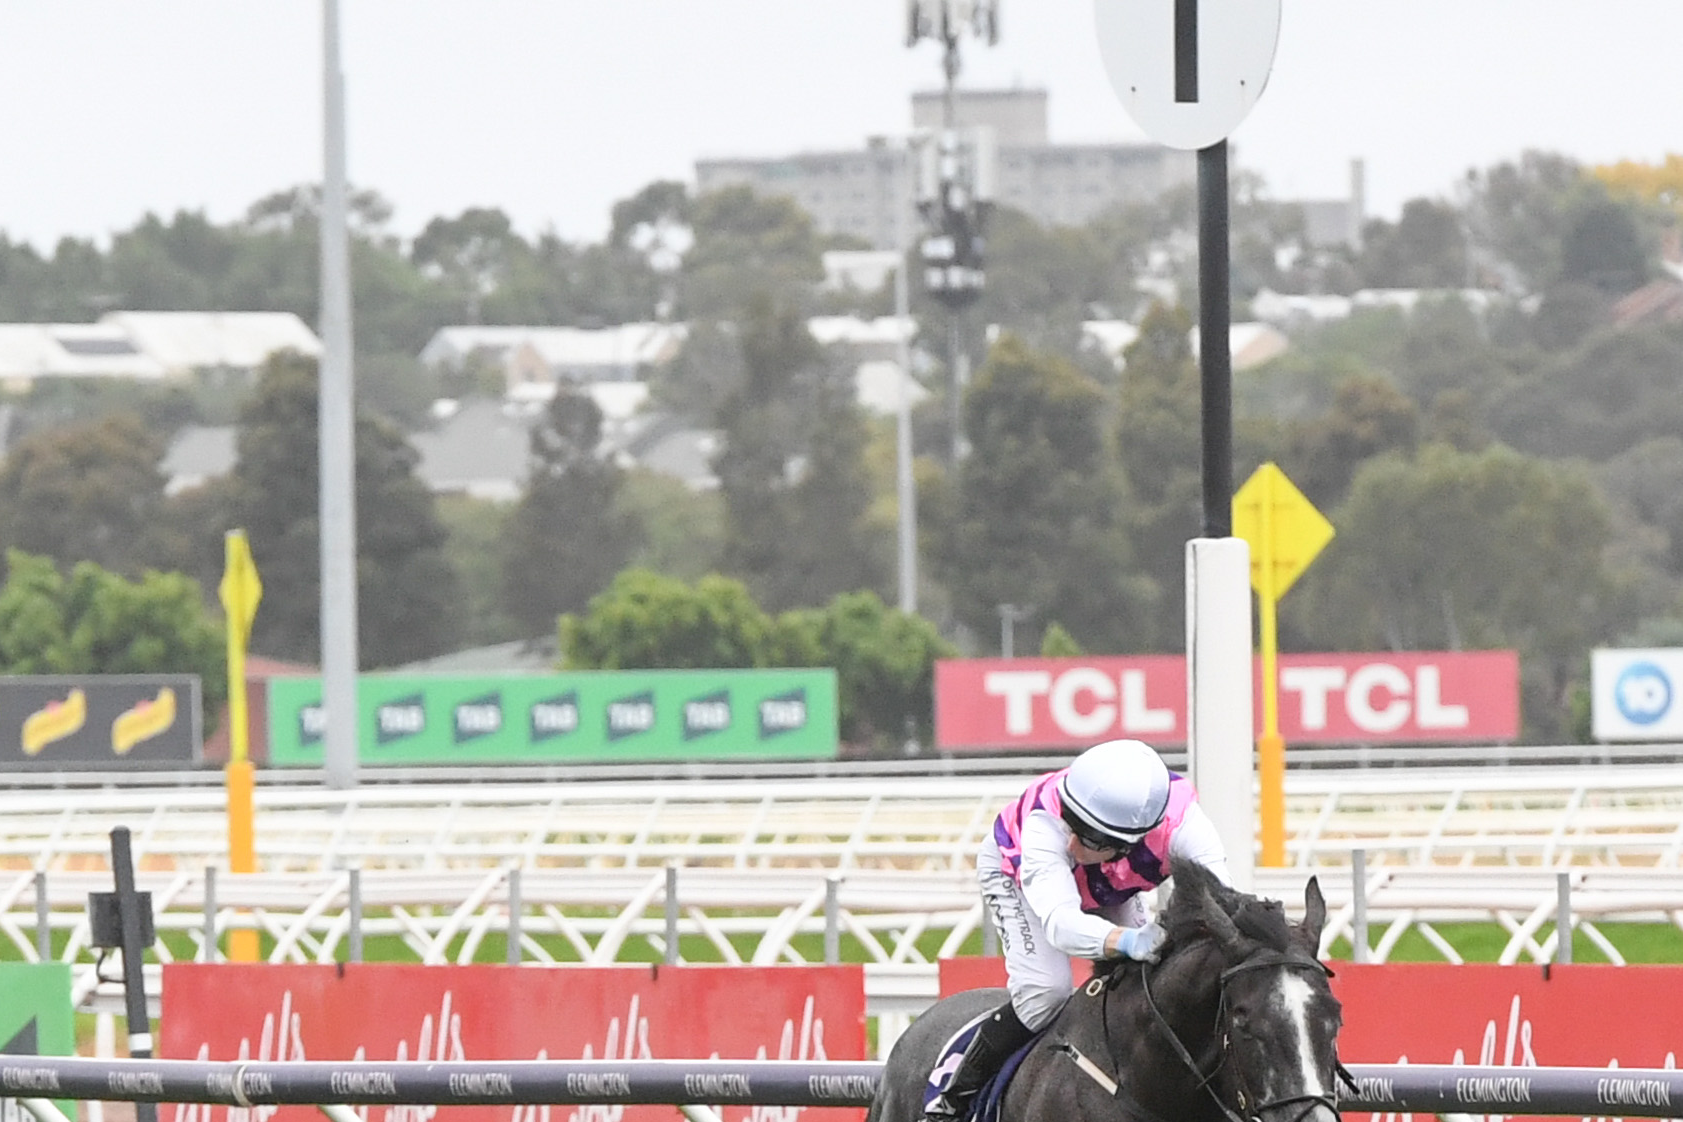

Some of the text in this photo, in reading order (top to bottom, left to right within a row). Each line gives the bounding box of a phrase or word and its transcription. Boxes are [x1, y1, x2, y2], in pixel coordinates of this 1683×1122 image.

[985, 668, 1175, 736] TCL
[1280, 663, 1469, 732] TCL
[1019, 919, 1036, 956] TRACK
[330, 1071, 396, 1095] FLEMINGTON
[449, 1073, 513, 1096] FLEMINGTON
[567, 1073, 630, 1096] FLEMINGTON
[685, 1074, 752, 1097] FLEMINGTON
[809, 1075, 878, 1098] FLEMINGTON
[1456, 1077, 1531, 1102] FLEMINGTON
[1597, 1078, 1671, 1107] FLEMINGTON
